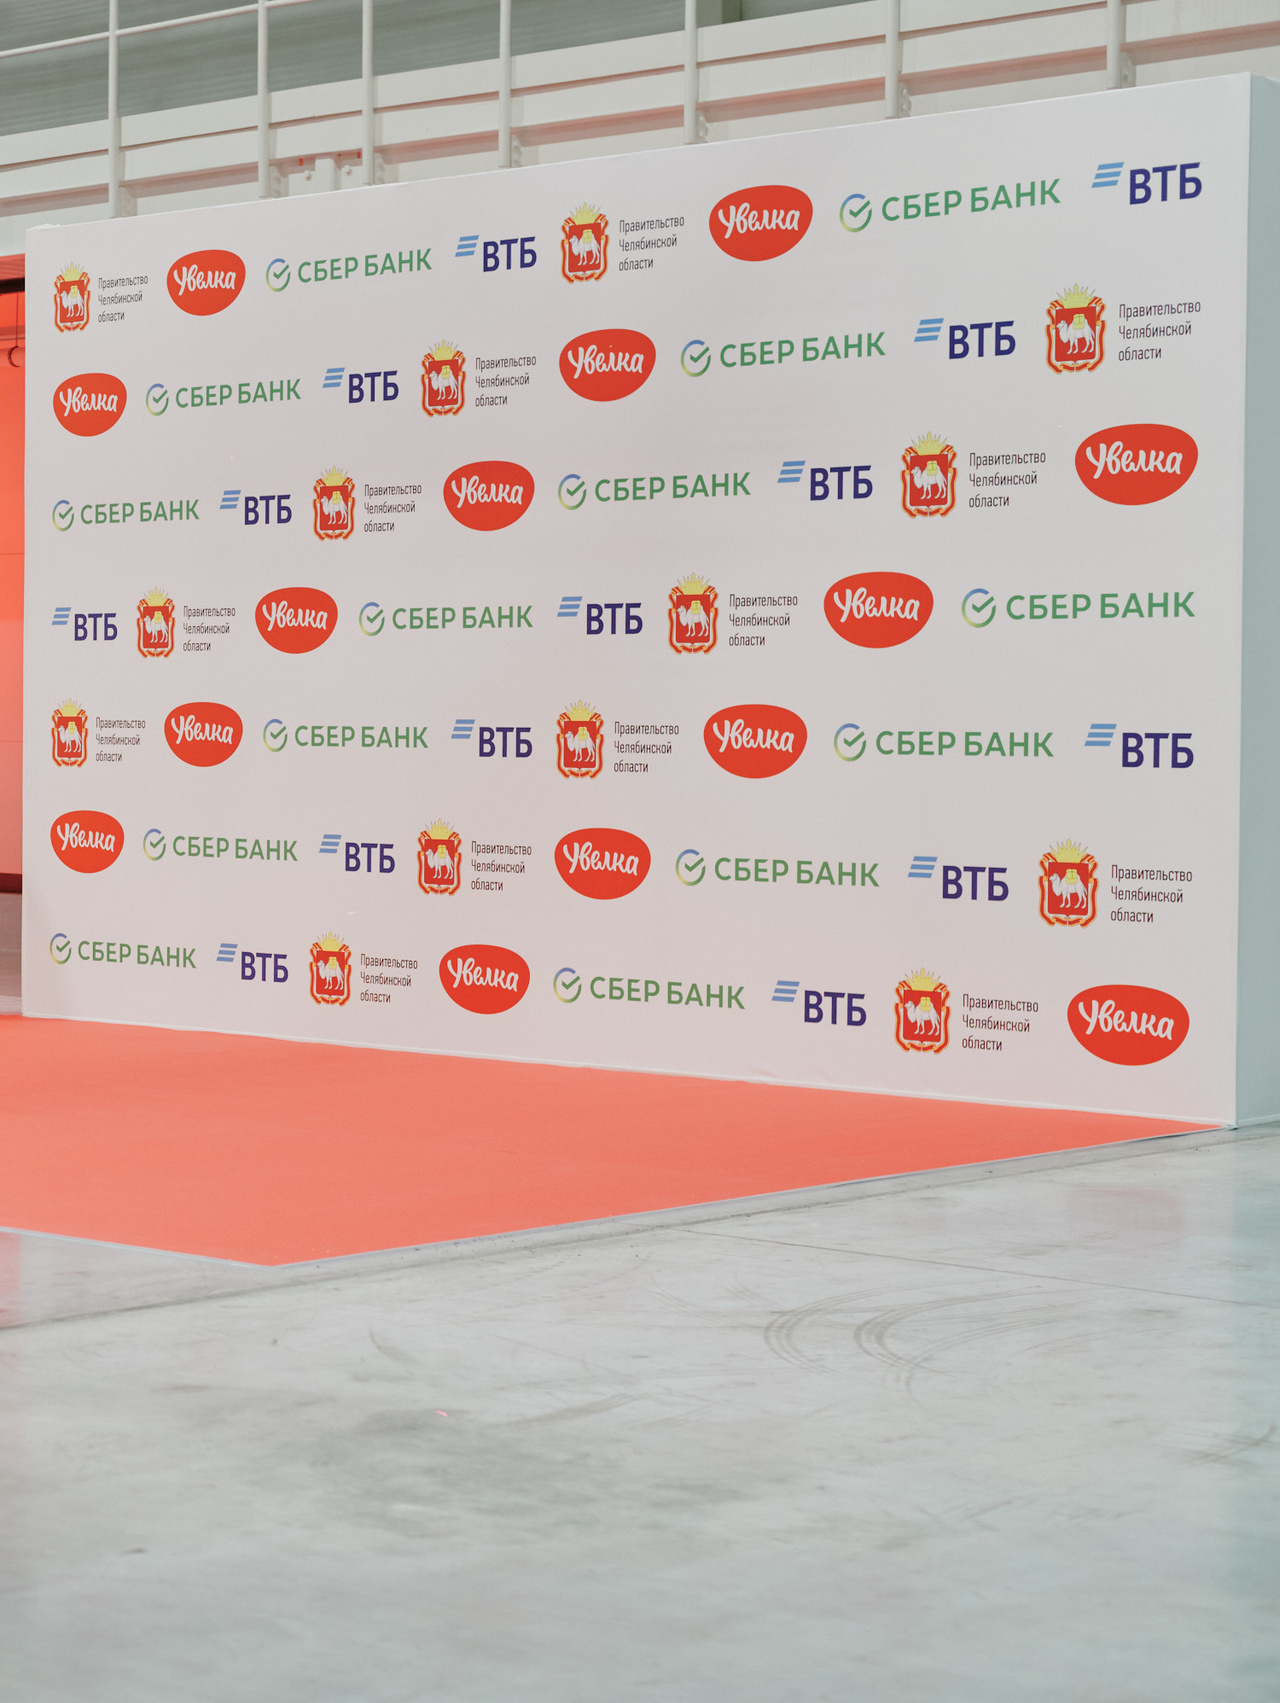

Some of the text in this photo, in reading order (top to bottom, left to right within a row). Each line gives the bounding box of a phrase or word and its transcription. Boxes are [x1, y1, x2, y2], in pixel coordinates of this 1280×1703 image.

[1130, 163, 1201, 204] ВТБ
[882, 179, 1060, 221] СБЕР БАНК
[620, 217, 684, 235] Правительство
[718, 203, 800, 238] Увелка
[619, 234, 677, 251] Челябинской
[484, 237, 536, 272] ВТБ
[619, 258, 653, 271] области
[298, 248, 431, 283] СБЕР БАНК
[99, 276, 148, 291] Правительство
[174, 265, 236, 295] Увелка
[98, 291, 142, 305] Челябинской
[98, 311, 124, 322] области
[1119, 302, 1201, 321] Правительство
[949, 321, 1015, 359] ВТБ
[1119, 321, 1191, 339] Челябинской
[721, 332, 885, 367] СБЕР БАНК
[1118, 346, 1161, 361] области
[476, 356, 536, 372] Правительство
[568, 345, 643, 378] Увелка
[349, 371, 398, 403] ВТБ
[476, 373, 529, 388] Челябинской
[60, 387, 118, 416] Увелка
[176, 379, 300, 408] СБЕР БАНК
[475, 394, 507, 407] области
[970, 453, 1046, 469] Правительство
[1086, 441, 1182, 479] Увелка
[595, 472, 750, 501] СБЕР БАНК
[811, 466, 872, 500] ВТБ
[969, 471, 1037, 487] Челябинской
[365, 484, 422, 499] Правительство
[452, 476, 523, 508] Увелка
[969, 494, 1009, 508] области
[81, 500, 198, 524] СБЕР БАНК
[245, 495, 291, 525] ВТБ
[364, 500, 415, 514] Челябинской
[364, 520, 394, 532] области
[730, 594, 798, 610] Правительство
[834, 588, 919, 622] Увелка
[1007, 592, 1195, 620] СБЕР БАНК
[184, 606, 235, 619] Правительство
[263, 601, 327, 631] Увелка
[393, 606, 532, 629] СБЕР БАНК
[587, 603, 642, 634] ВТБ
[729, 613, 790, 627] Челябинской
[75, 613, 117, 640] ВТБ
[183, 622, 230, 634] Челябинской
[183, 640, 211, 651] области
[729, 633, 765, 646] области
[96, 717, 145, 730] Правительство
[171, 715, 233, 744] Увелка
[615, 721, 679, 737] Правительство
[96, 734, 140, 745] Челябинской
[296, 726, 427, 747] СБЕР БАНК
[480, 727, 532, 757] ВТБ
[713, 719, 794, 752] Увелка
[877, 731, 1053, 757] СБЕР БАНК
[96, 750, 122, 761] области
[614, 741, 671, 754] Челябинской
[1122, 733, 1193, 768] ВТБ
[614, 759, 648, 772] области
[57, 823, 115, 852] Увелка
[173, 836, 296, 860] СБЕР БАНК
[346, 843, 394, 873] ВТБ
[472, 841, 532, 856] Правительство
[471, 859, 525, 873] Челябинской
[563, 842, 638, 875] Увелка
[715, 858, 878, 886] СБЕР БАНК
[1112, 865, 1192, 882] Правительство
[471, 878, 503, 891] области
[943, 866, 1008, 901] ВТБ
[1111, 886, 1183, 903] Челябинской
[1111, 907, 1153, 923] области
[79, 941, 195, 967] СБЕР БАНК
[361, 953, 418, 969] Правительство
[242, 952, 288, 982] ВТБ
[447, 958, 518, 991] Увелка
[361, 971, 411, 986] Челябинской
[360, 989, 390, 1003] области
[591, 977, 744, 1008] СБЕР БАНК
[805, 991, 866, 1026] ВТБ
[963, 994, 1038, 1012] Правительство
[963, 1014, 1030, 1032] Челябинской
[1079, 1000, 1174, 1040] Увелка
[962, 1035, 1002, 1051] области
